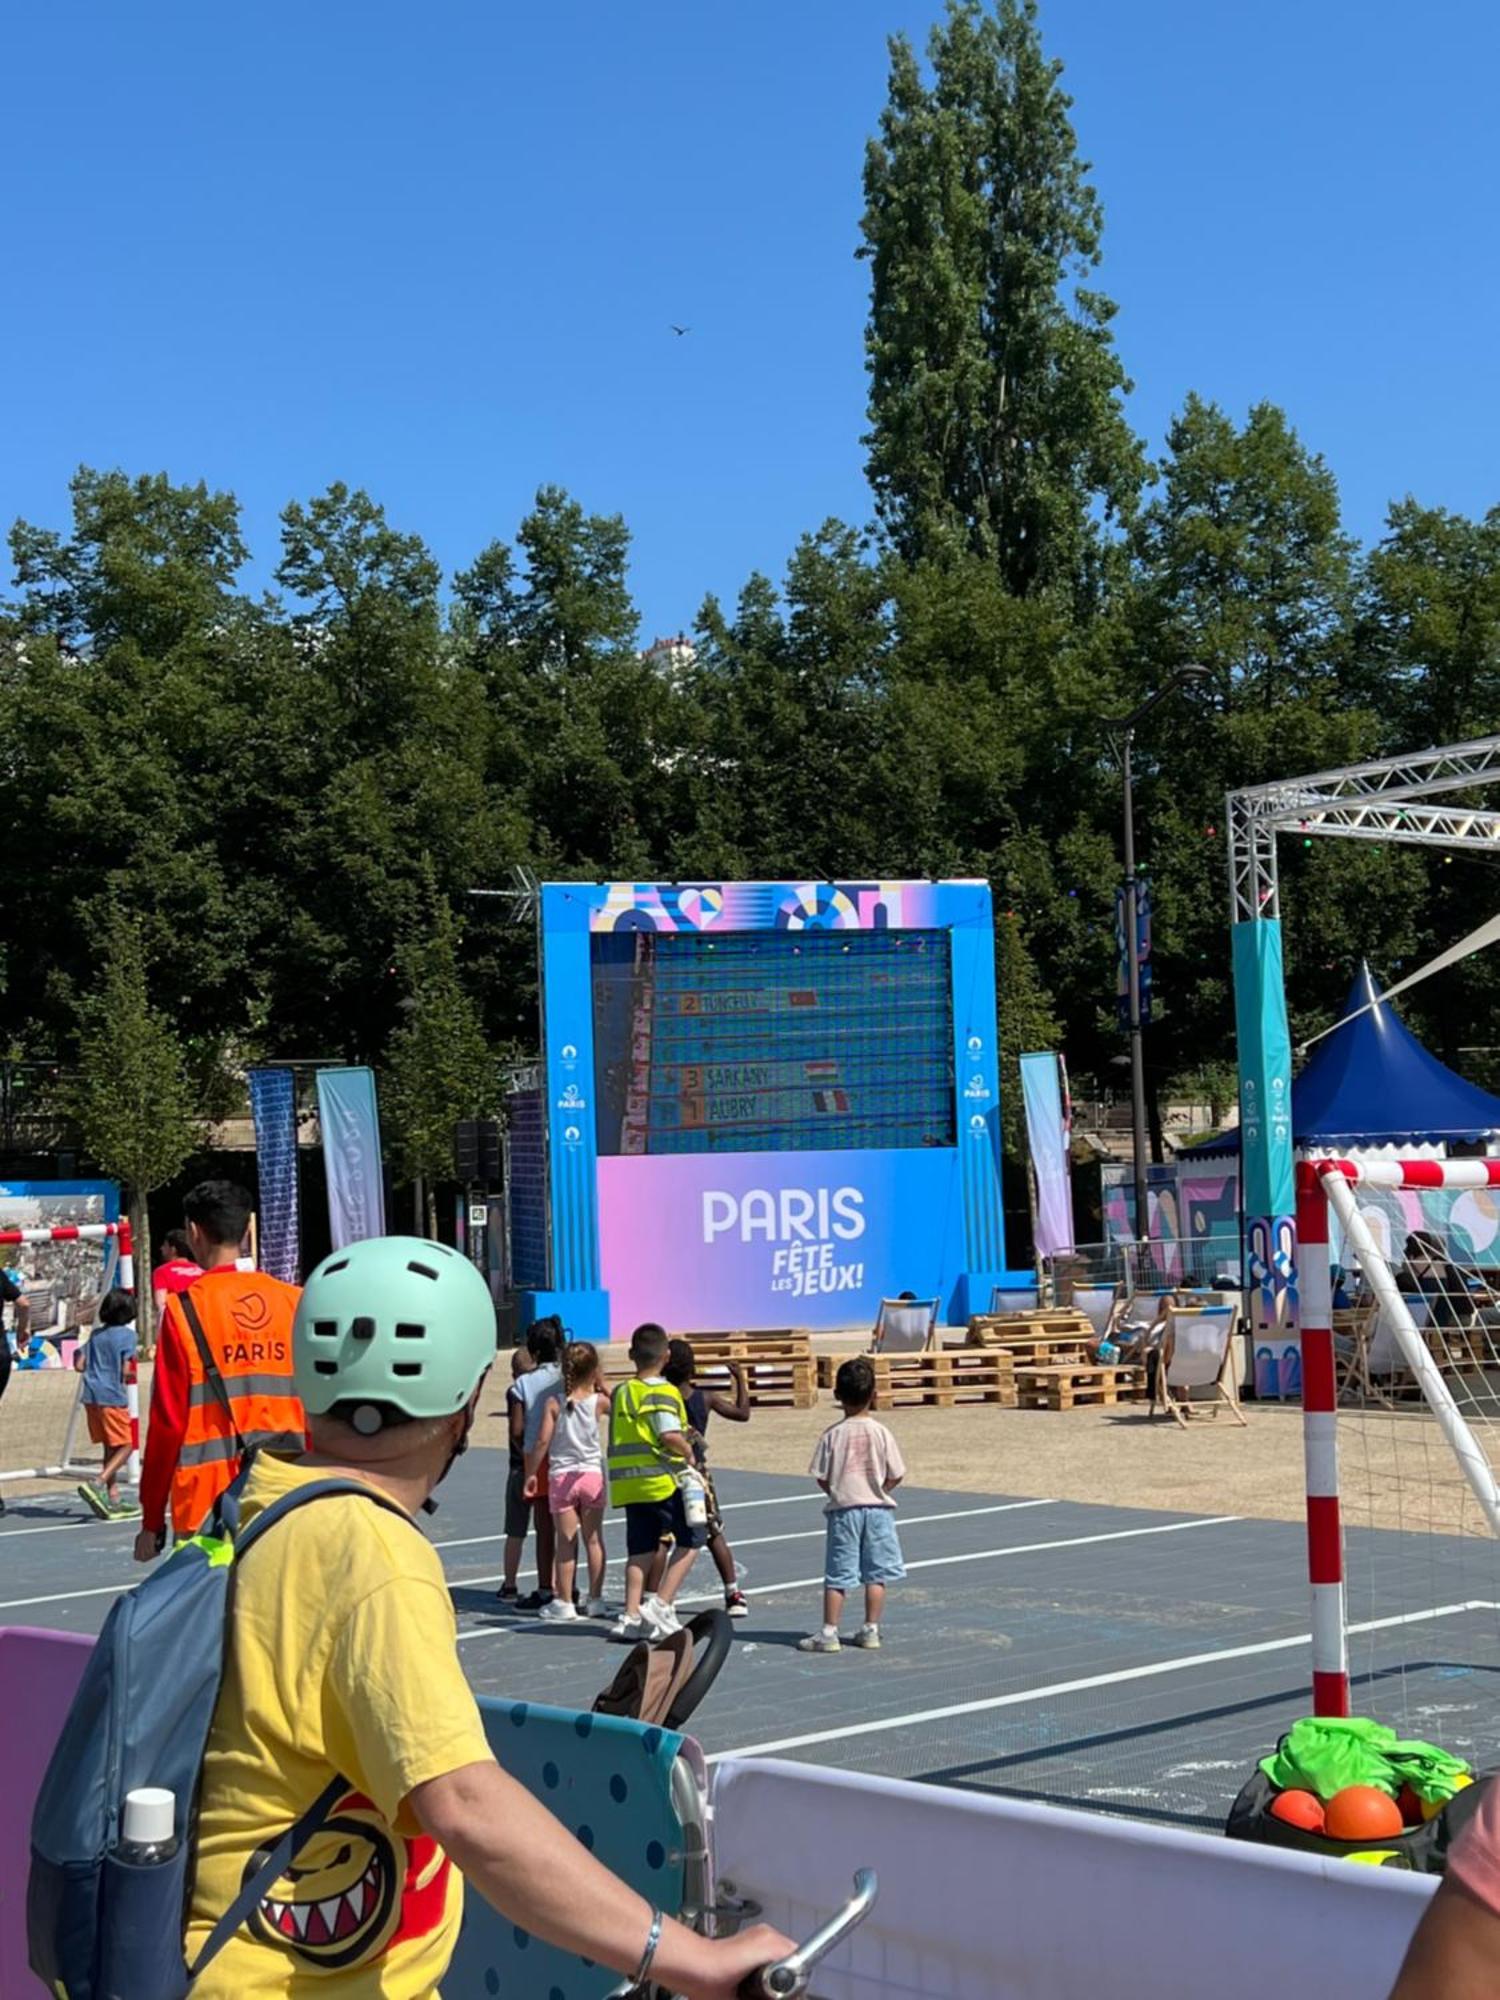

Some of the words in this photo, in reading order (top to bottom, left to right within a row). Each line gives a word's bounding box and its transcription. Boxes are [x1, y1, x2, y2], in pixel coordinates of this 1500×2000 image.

[685, 997, 695, 1010] 2
[687, 1070, 698, 1089] 3
[707, 1067, 769, 1089] SARKANY
[710, 1096, 757, 1120] AUBRY
[703, 1186, 866, 1243] PARIS
[772, 1239, 835, 1276] FÊTE
[771, 1277, 793, 1291] LES
[792, 1263, 864, 1297] JEUX!
[222, 1341, 285, 1364] PARIS
